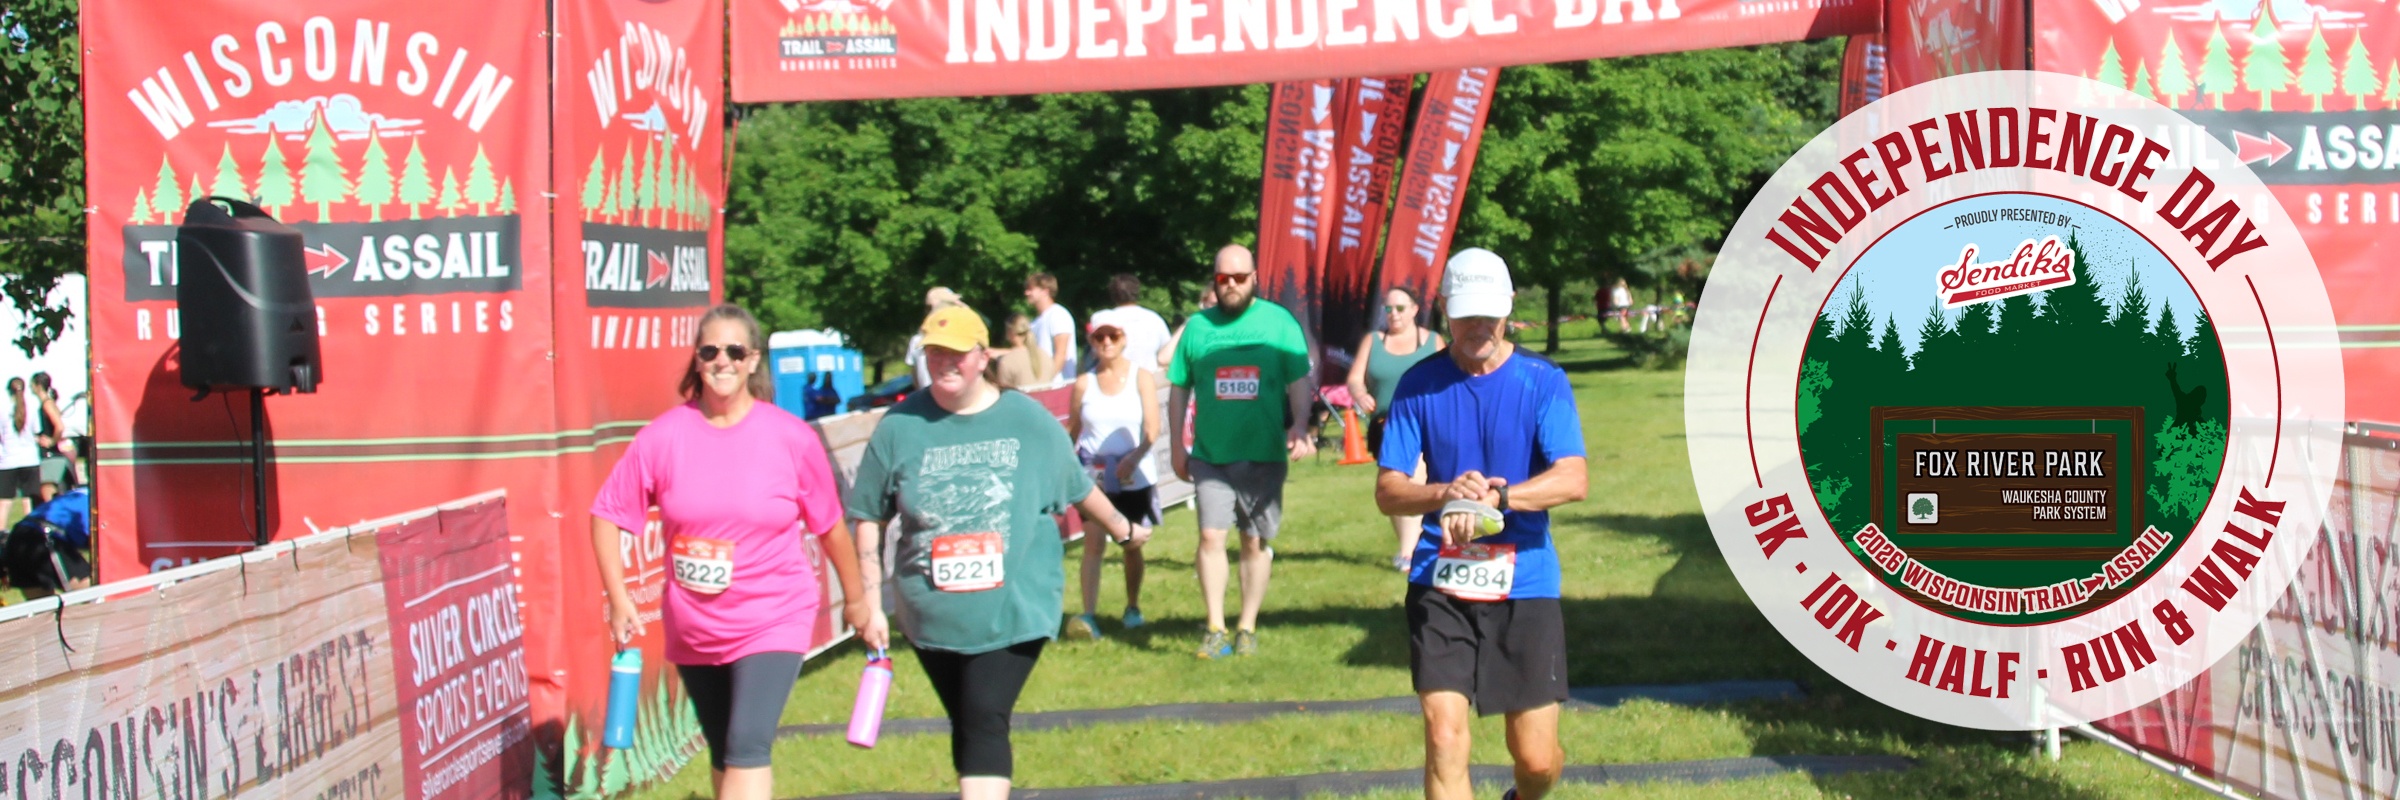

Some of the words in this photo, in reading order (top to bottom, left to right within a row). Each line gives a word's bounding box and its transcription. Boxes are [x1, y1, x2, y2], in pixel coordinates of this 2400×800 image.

[782, 40, 824, 55] TRAIL
[845, 38, 895, 54] ASSAIL
[127, 16, 513, 140] WISCONSIN
[2297, 124, 2400, 170] ASSA
[1339, 145, 1374, 253] ASSAIL
[2308, 193, 2400, 224] SERI
[352, 229, 510, 283] ASSAIL
[581, 240, 643, 292] RAIL
[365, 300, 514, 336] SERIES
[1219, 381, 1257, 394] 5180
[675, 560, 727, 585] 5222
[938, 560, 995, 582] 5221
[1437, 563, 1507, 590] 4984
[409, 604, 465, 687] SILVER
[467, 583, 523, 656] CIRCLE
[252, 629, 374, 786] LARGEST
[415, 673, 471, 755] SPORTS
[472, 647, 529, 721] EVENTS
